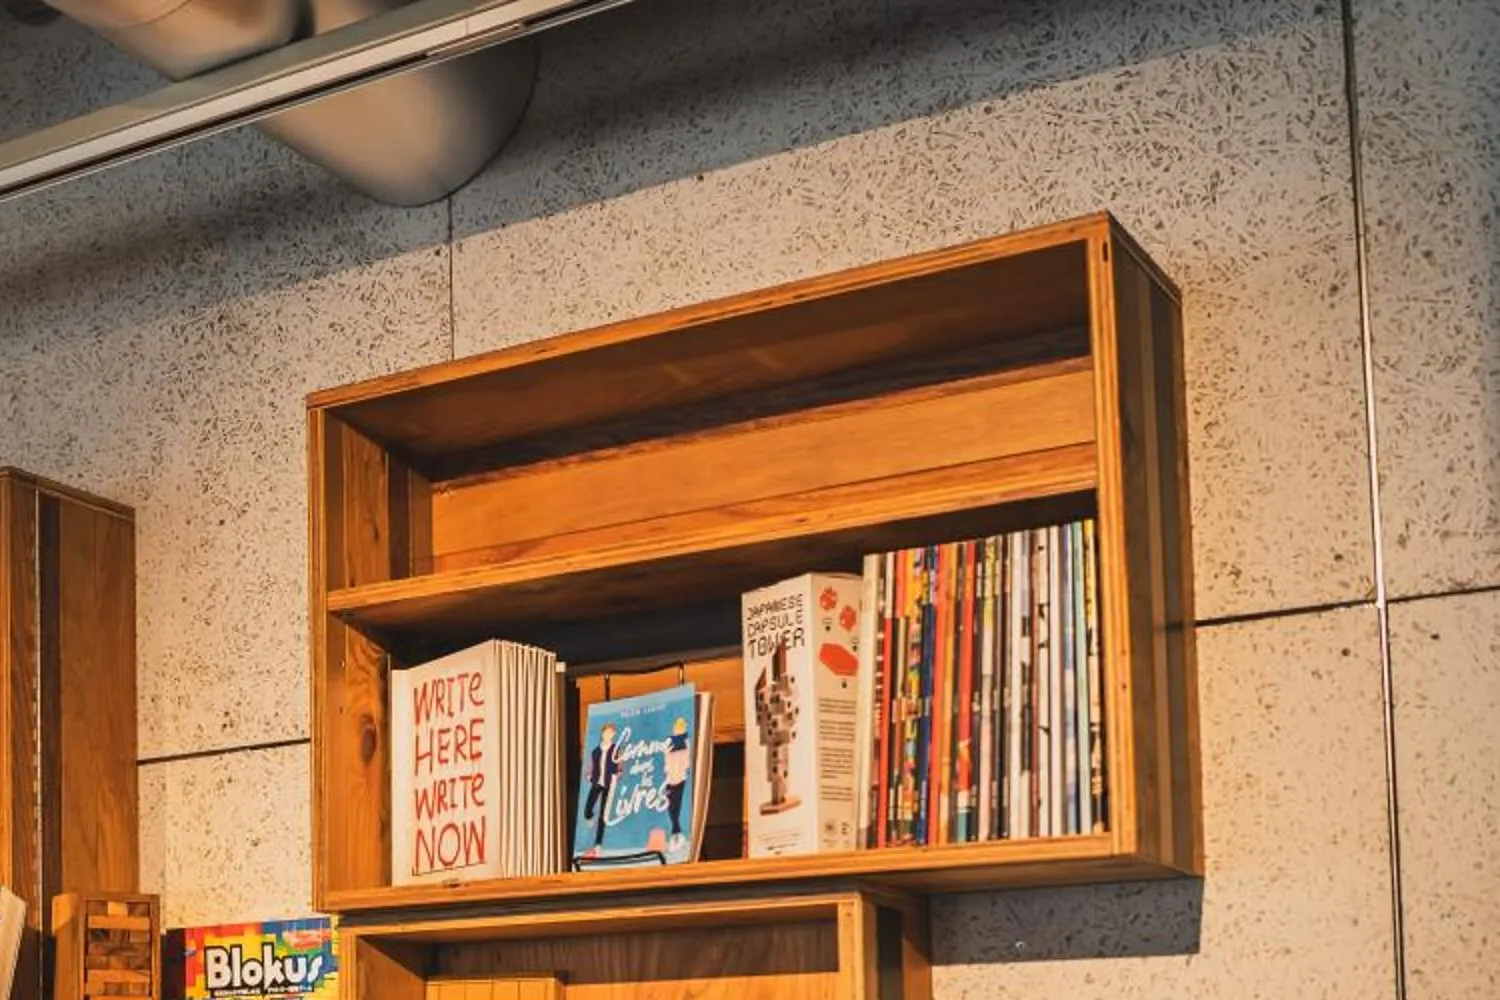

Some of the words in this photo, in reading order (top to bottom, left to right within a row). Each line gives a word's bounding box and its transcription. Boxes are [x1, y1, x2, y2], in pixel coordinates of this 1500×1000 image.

[747, 593, 803, 621] JAPANESE
[747, 609, 804, 639] CAPSULE
[748, 627, 805, 659] TOWER
[414, 717, 485, 777] HERE
[414, 815, 486, 874] NOW
[204, 941, 324, 992] Blokus
